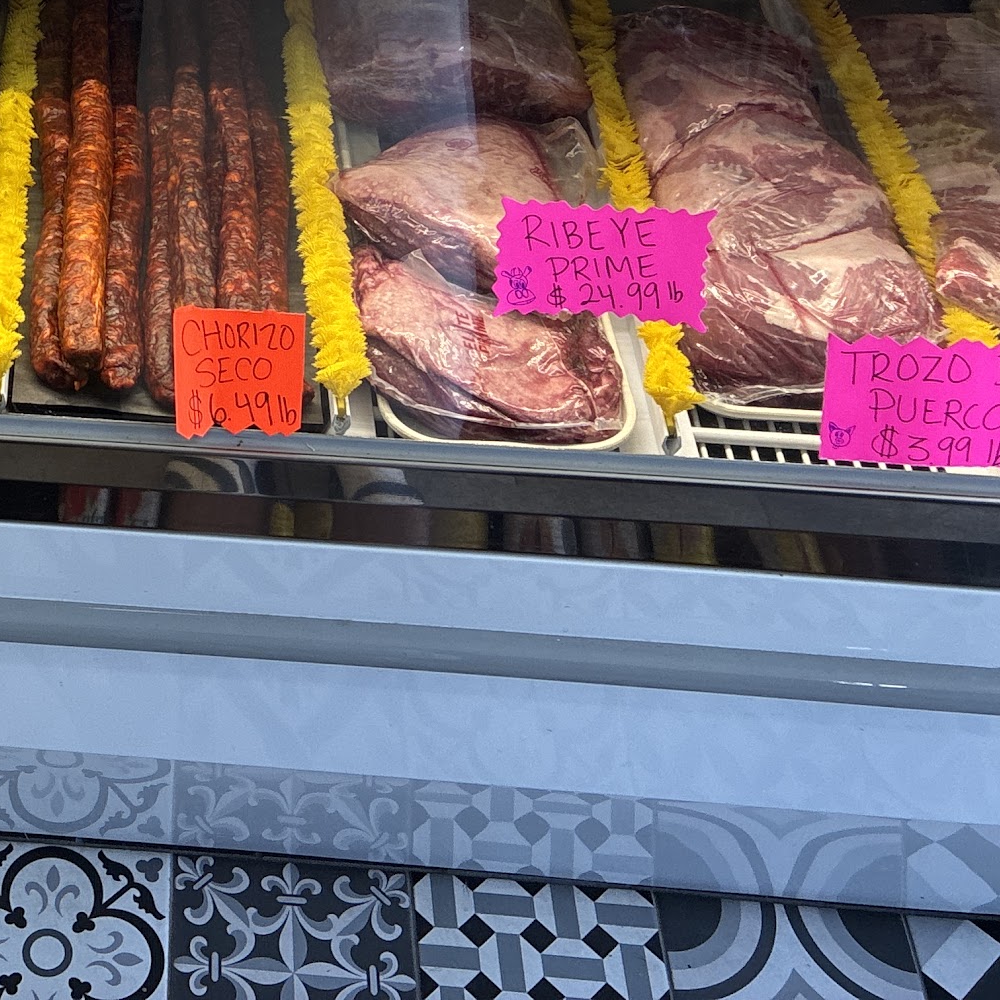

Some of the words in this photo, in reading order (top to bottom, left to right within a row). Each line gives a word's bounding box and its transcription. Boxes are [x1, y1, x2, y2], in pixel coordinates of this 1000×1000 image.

[521, 214, 657, 251] RIBEYE
[545, 254, 658, 282] PRIME
[667, 281, 684, 304] lb
[181, 319, 295, 356] CHORIZO
[195, 357, 273, 388] SECO
[841, 350, 972, 385] TROZO
[277, 394, 297, 426] lb
